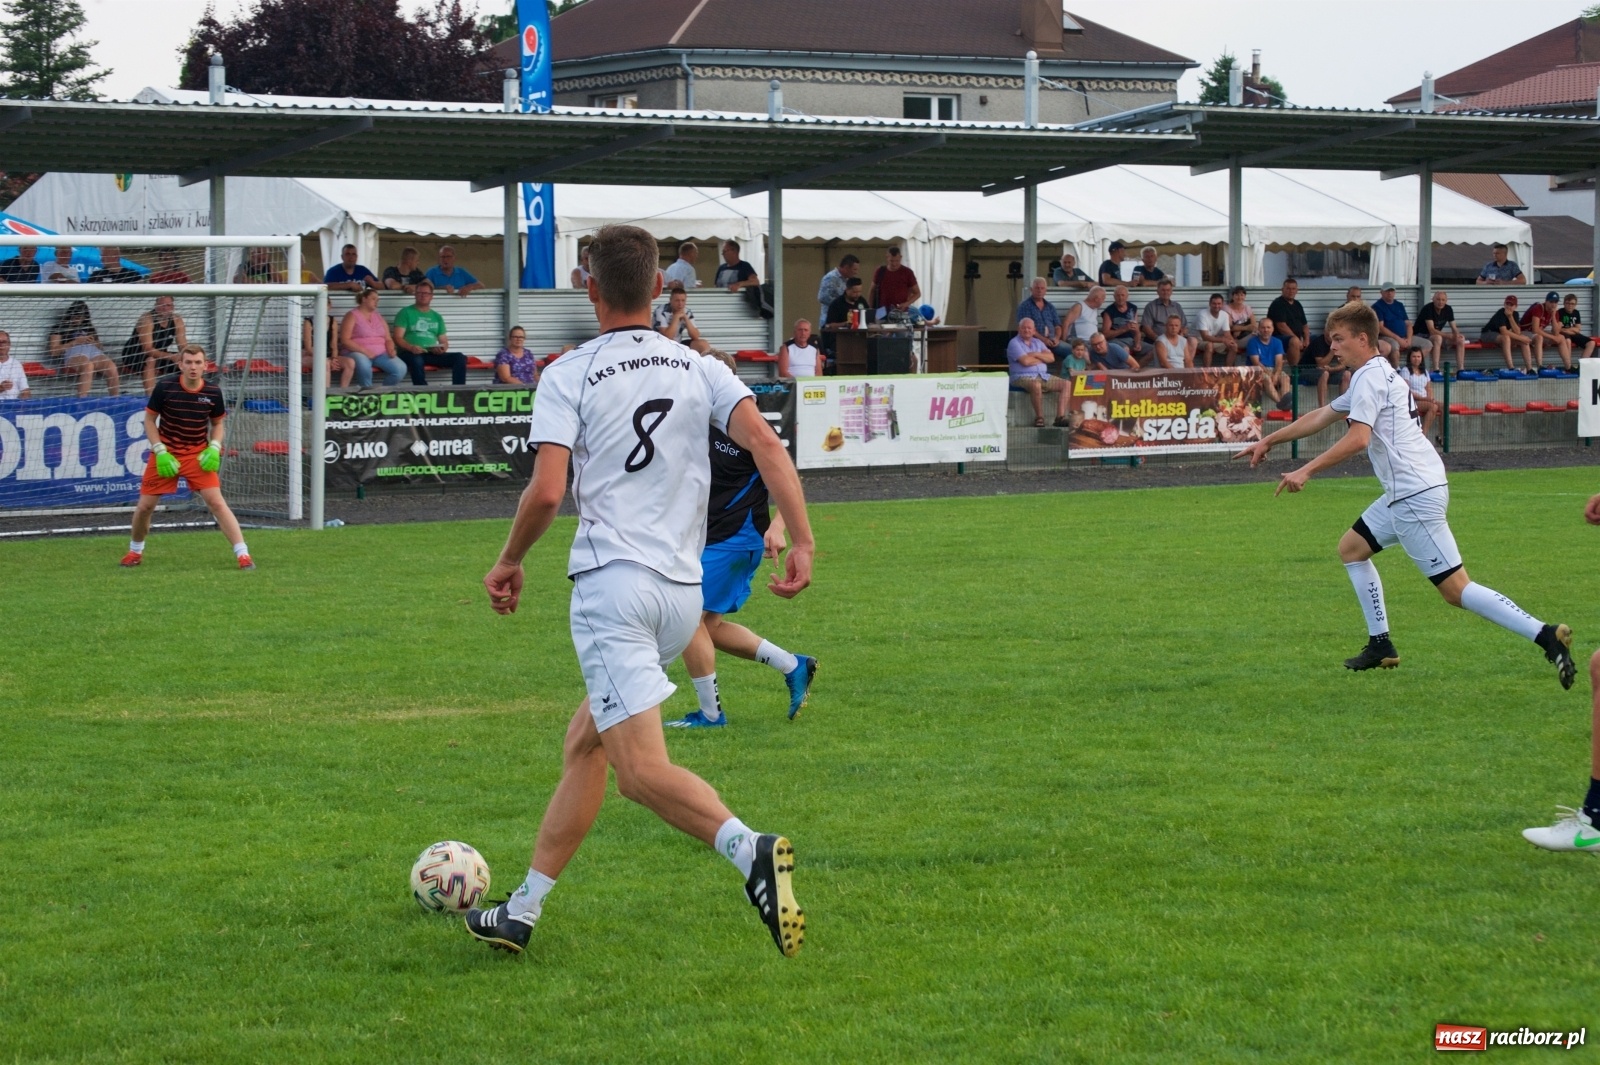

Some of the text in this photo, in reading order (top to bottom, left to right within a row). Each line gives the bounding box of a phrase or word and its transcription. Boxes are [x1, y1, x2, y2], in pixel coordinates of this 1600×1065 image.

[588, 366, 616, 386] LKS
[1111, 378, 1151, 390] Producent
[929, 396, 974, 420] H40
[1111, 399, 1187, 418] kiełbasa
[325, 418, 425, 429] PROFESJONALNA
[426, 416, 495, 427] HURTOWNIA
[1143, 408, 1216, 442] szefa
[625, 398, 674, 473] 8
[344, 438, 473, 459] JAKO errea
[714, 440, 740, 457] safer
[965, 445, 1000, 454] KERAKOLL
